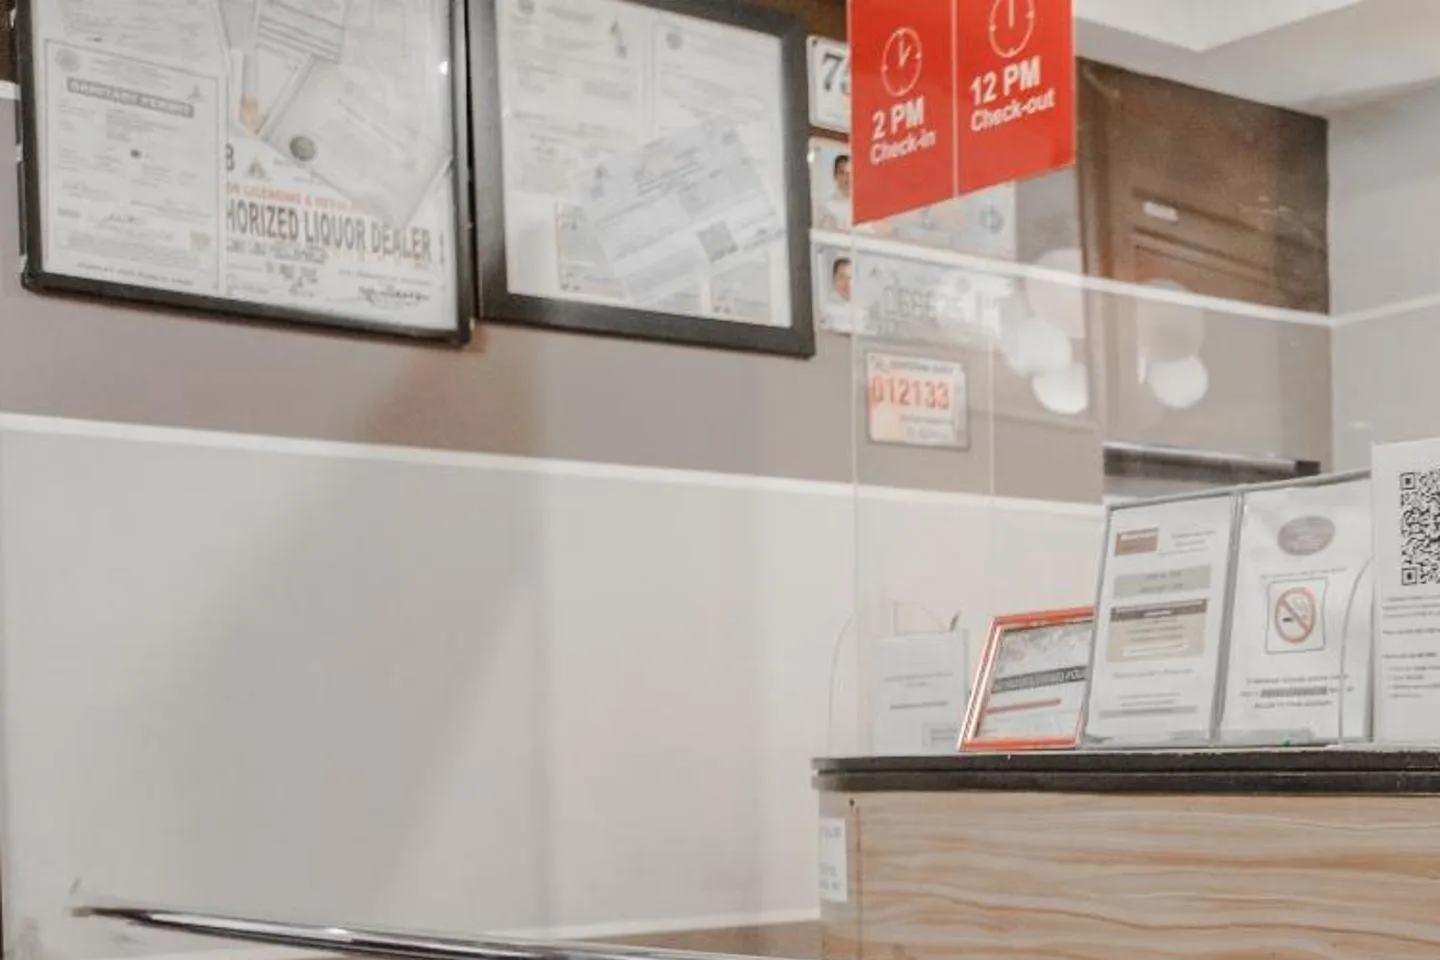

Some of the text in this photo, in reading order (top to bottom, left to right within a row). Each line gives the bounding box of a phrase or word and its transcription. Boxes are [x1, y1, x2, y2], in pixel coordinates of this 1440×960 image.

[970, 55, 1041, 106] 12 PM
[872, 95, 925, 142] 2 PM
[970, 88, 1056, 132] Check-out
[869, 129, 937, 165] Check-in
[304, 211, 366, 251] LIQUOR
[370, 221, 432, 262] DEALER
